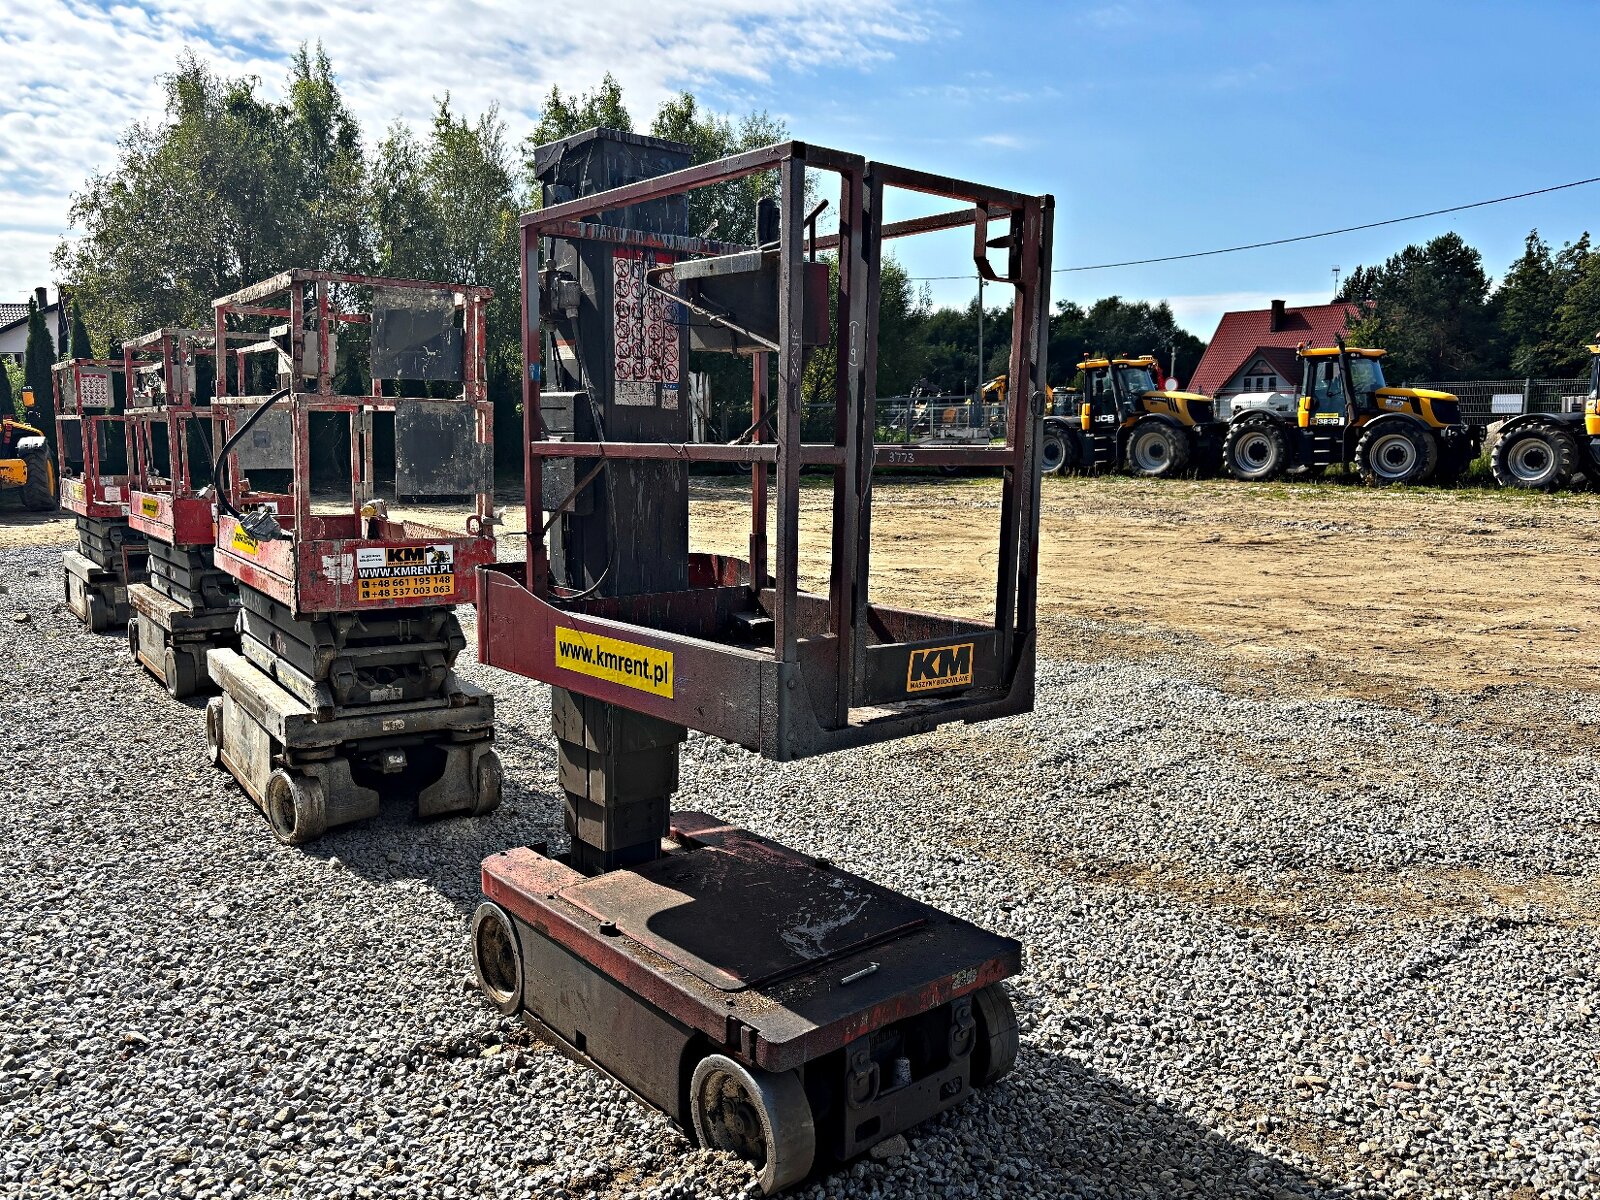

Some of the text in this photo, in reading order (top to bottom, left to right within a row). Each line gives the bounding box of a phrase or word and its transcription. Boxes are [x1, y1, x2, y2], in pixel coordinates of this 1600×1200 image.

[1094, 414, 1115, 423] JCB
[888, 451, 915, 463] 3773
[387, 548, 425, 562] KM
[358, 564, 453, 578] WWW.KMRENT.PL
[371, 575, 451, 589] +48 661 195 148
[371, 585, 451, 598] +48 537 003 063
[559, 640, 668, 687] www.kmrent.pl
[910, 646, 972, 681] KM
[937, 674, 970, 686] BUDOWLANE
